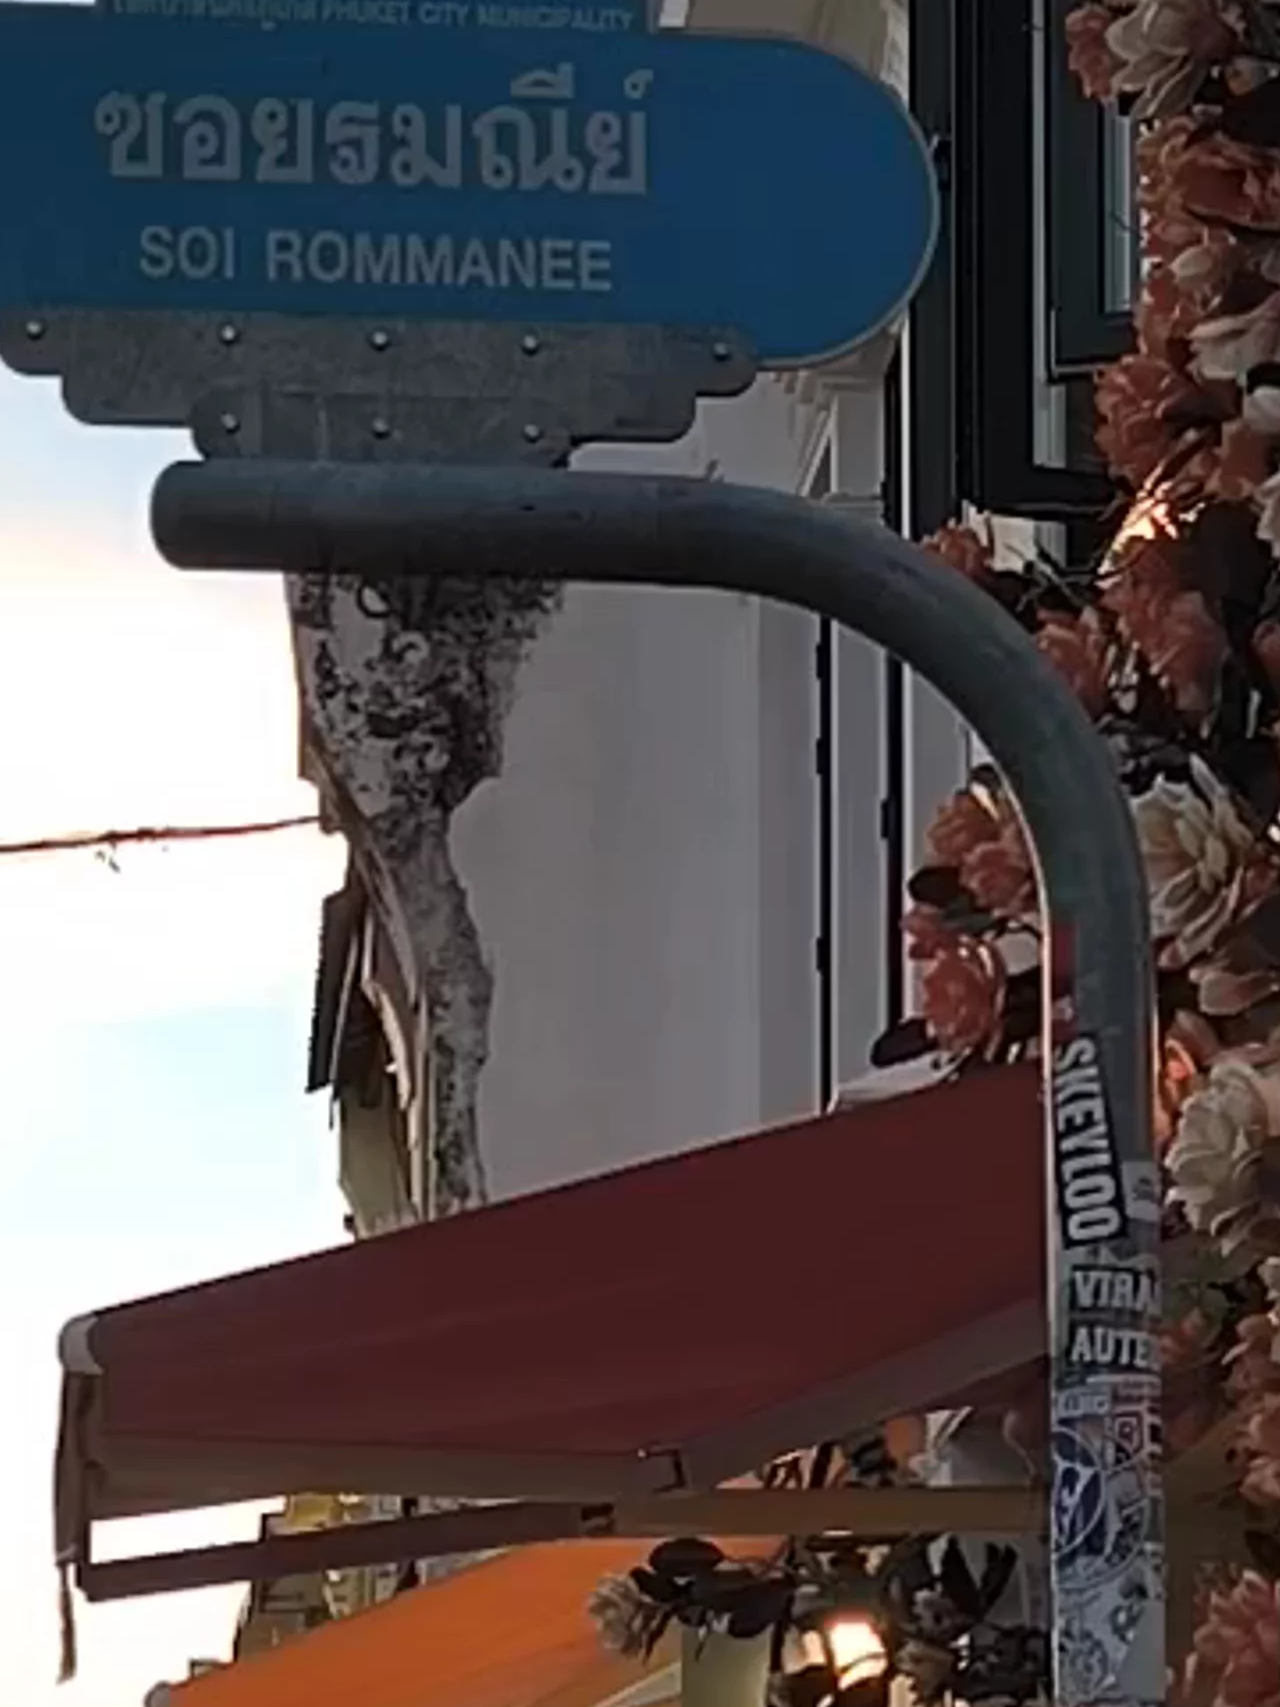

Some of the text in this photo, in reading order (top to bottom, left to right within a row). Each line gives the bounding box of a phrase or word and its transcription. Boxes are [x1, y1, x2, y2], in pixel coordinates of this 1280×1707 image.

[419, 1, 468, 27] CITY
[477, 4, 634, 32] MUNICIPALITY
[95, 62, 653, 194] ซอยรมณีย์
[139, 225, 612, 291] SOI ROMMANEE
